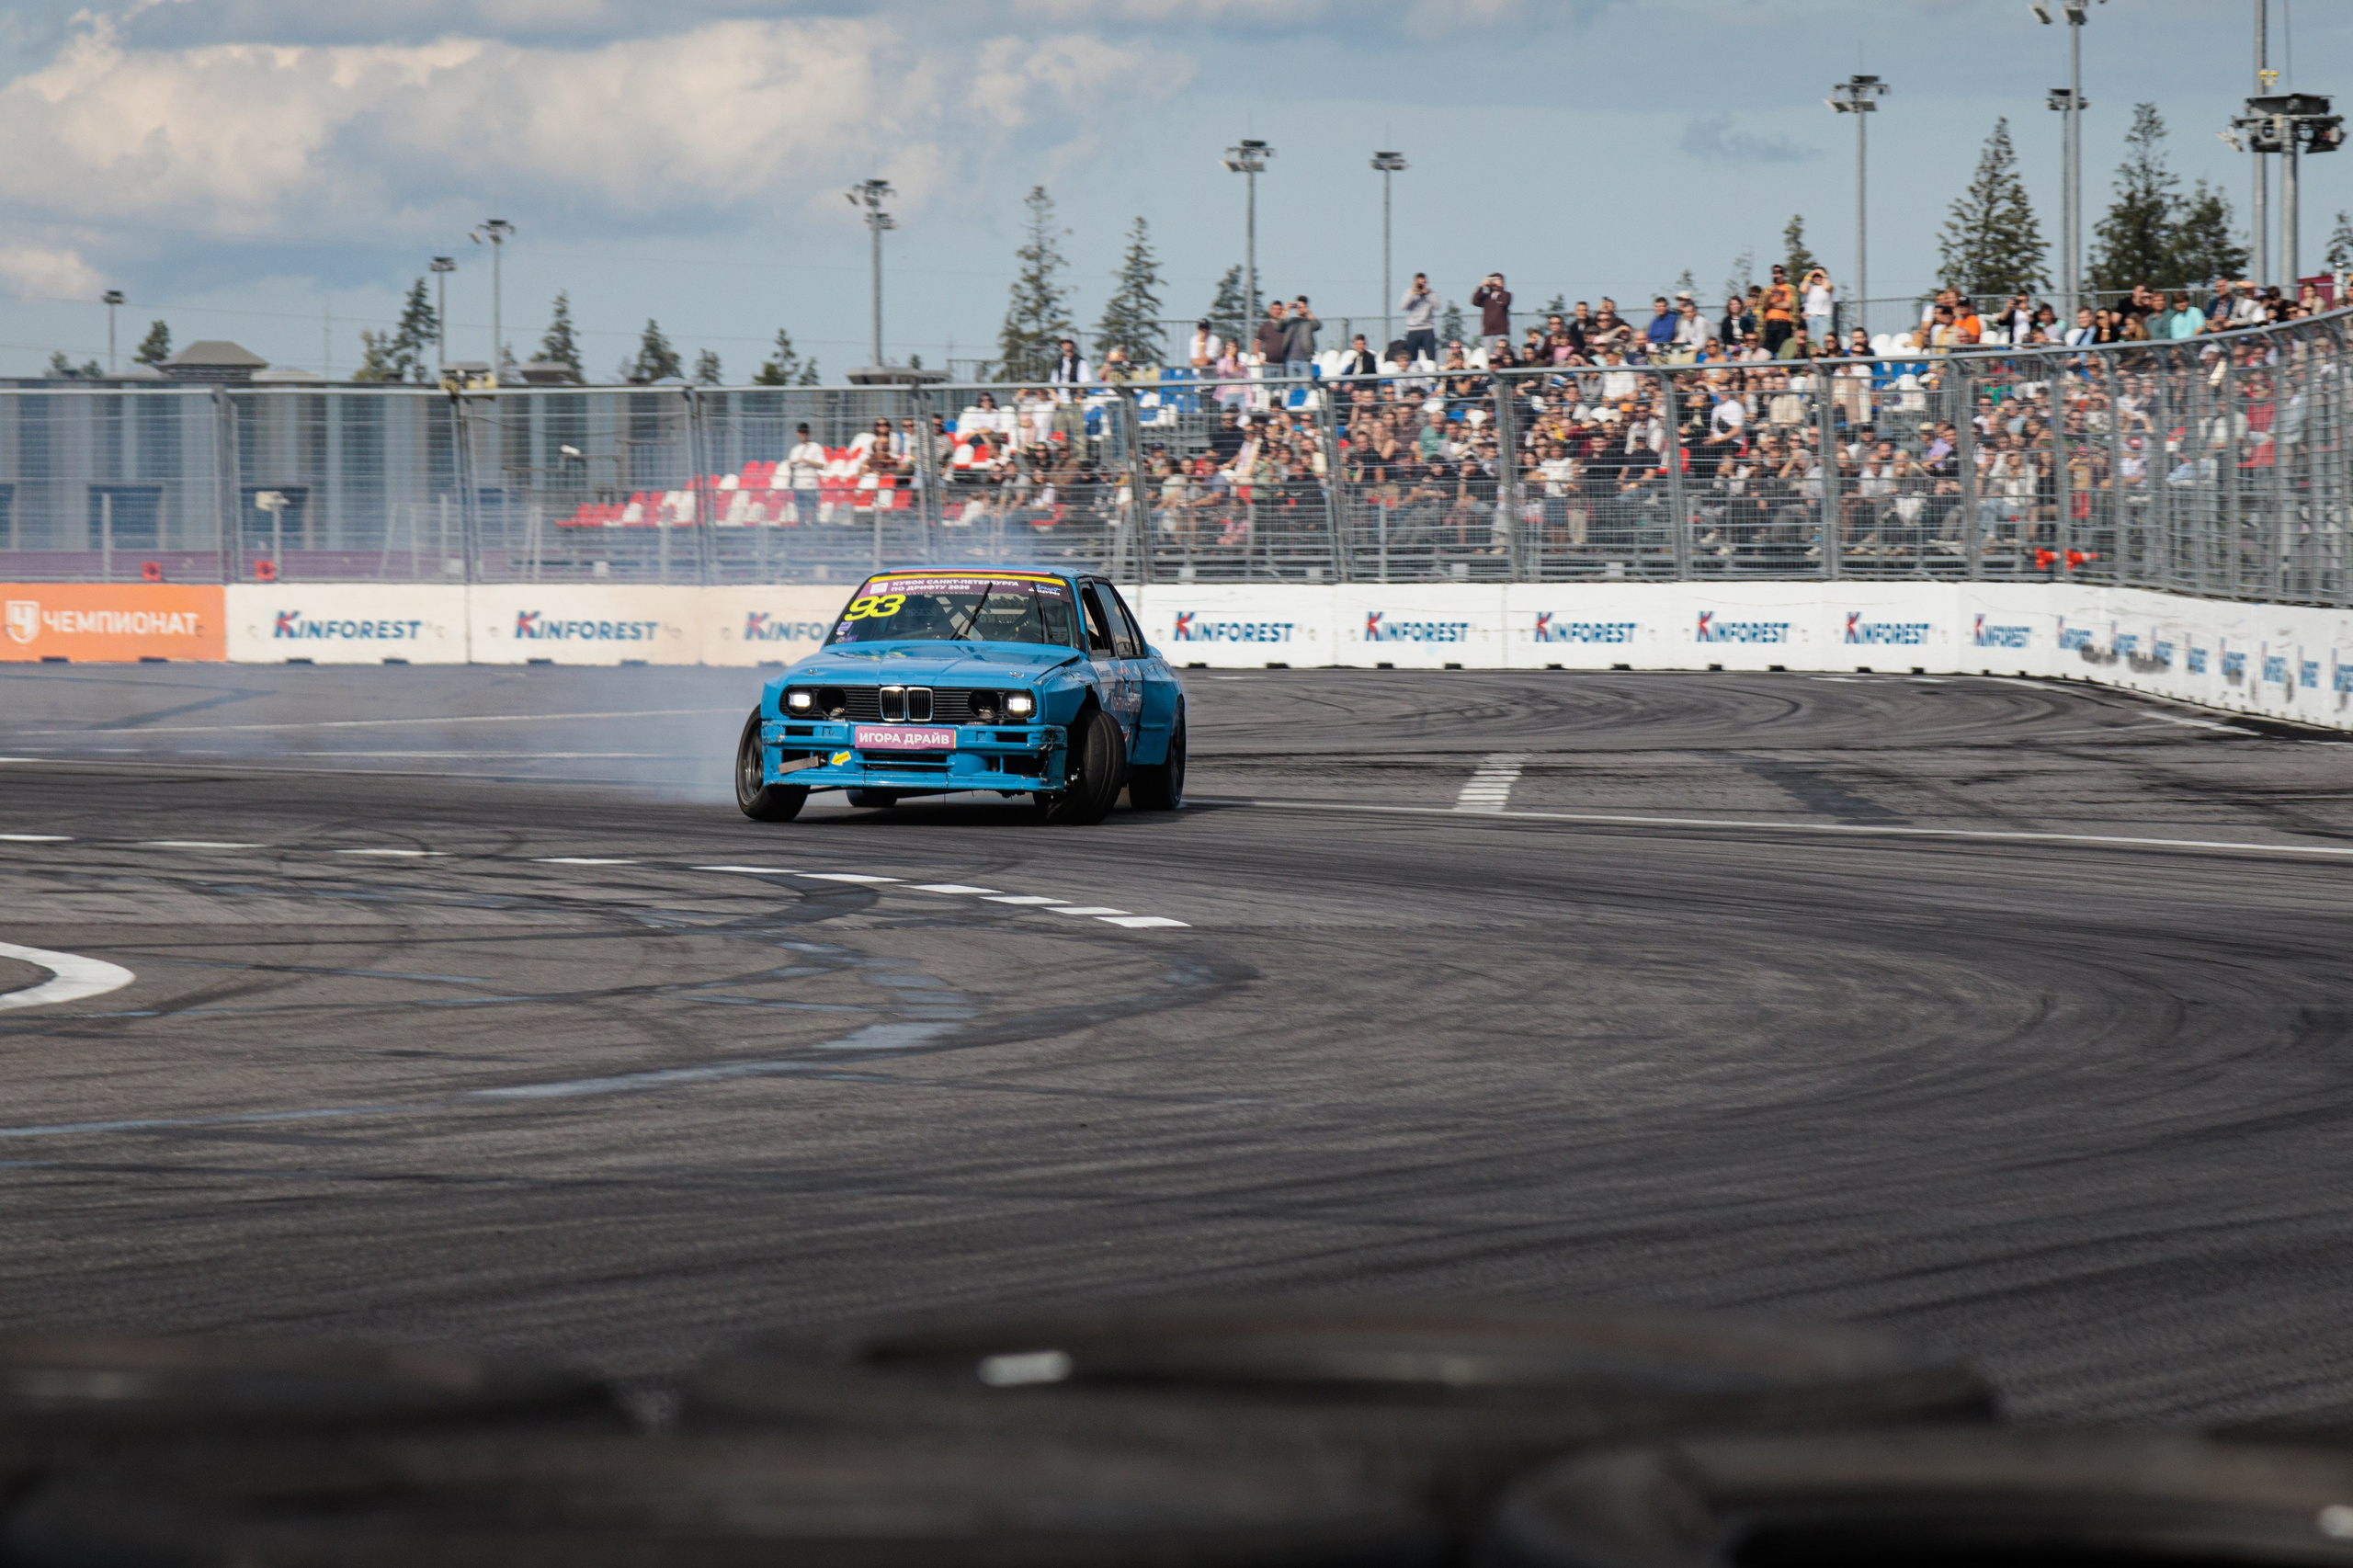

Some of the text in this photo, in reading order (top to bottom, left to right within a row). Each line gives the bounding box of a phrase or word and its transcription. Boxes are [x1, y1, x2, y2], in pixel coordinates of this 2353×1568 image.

[926, 579, 1019, 587] САНКТ-ПЕТЕРБУРГА
[42, 610, 199, 635] ЧЕМПИОНАТ
[844, 594, 906, 621] 93
[274, 610, 421, 640] KINFOREST
[515, 610, 659, 641] KINFOREST
[1174, 611, 1293, 642] KINFOREST
[1366, 611, 1469, 642] KINFOREST
[1534, 611, 1637, 643] KINFOREST
[1697, 611, 1789, 643] KINFOREST
[1845, 611, 1929, 644] KINFOREST
[858, 732, 950, 745] ИГОРА ДРАЙВ
